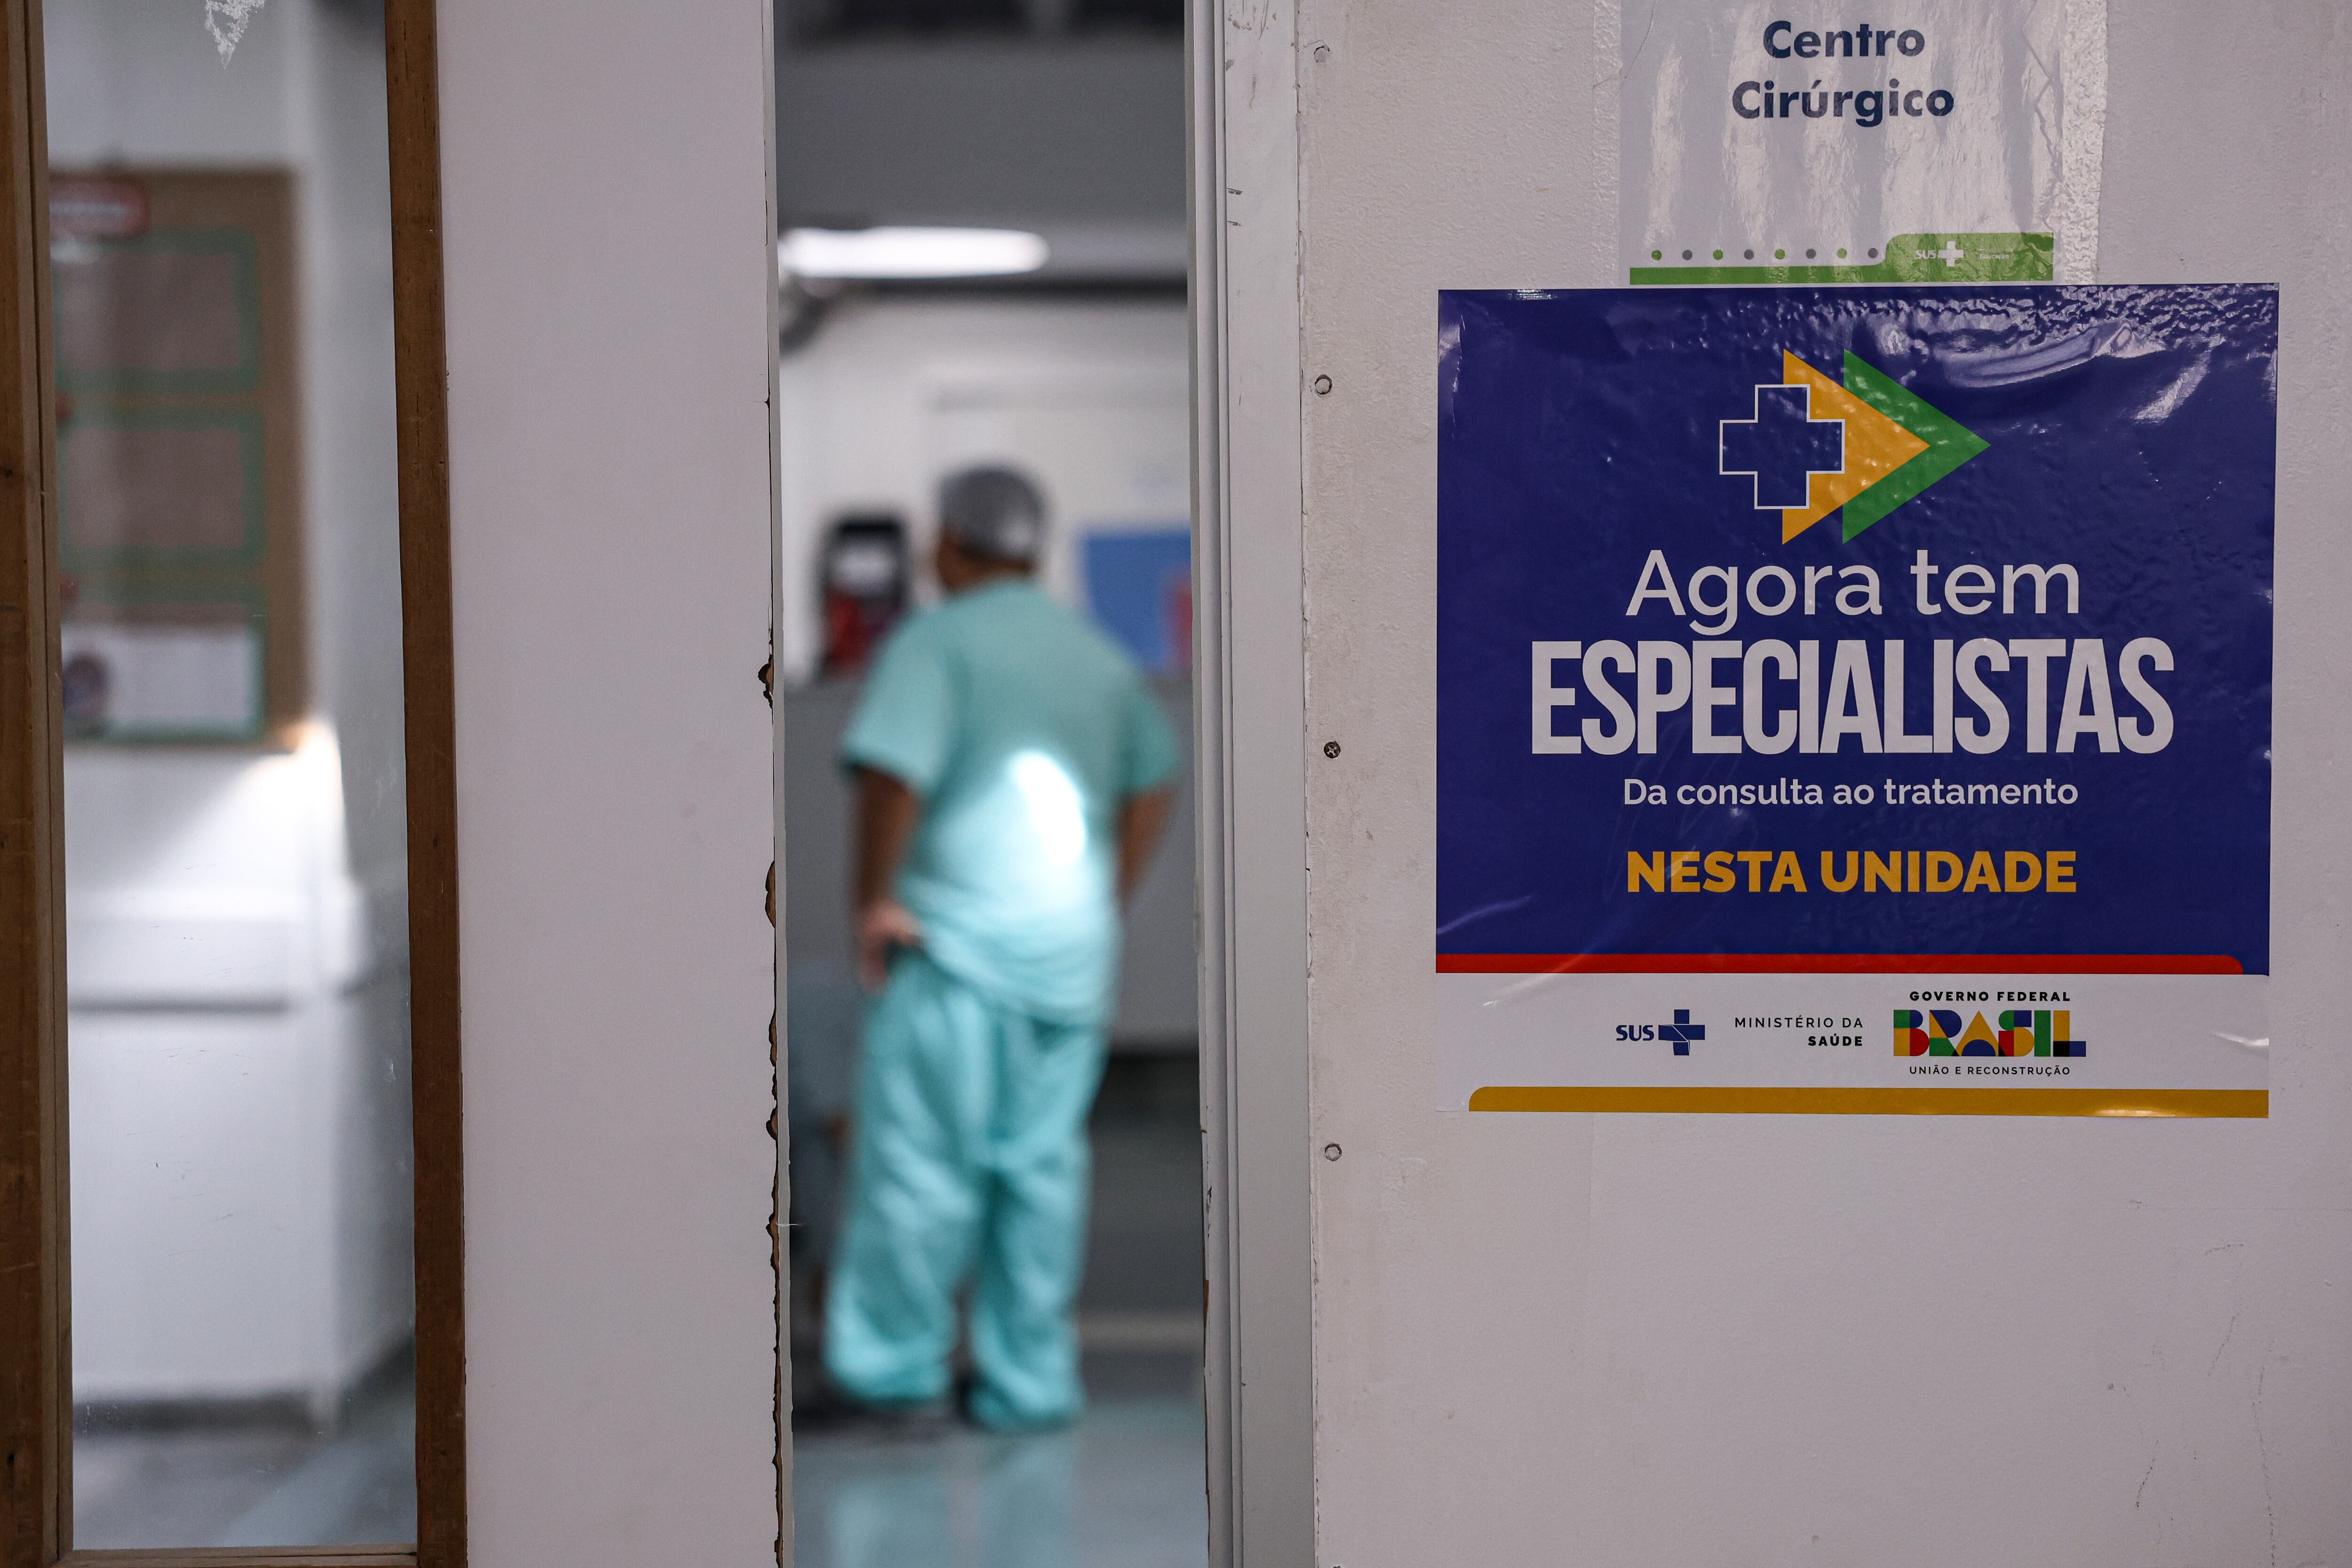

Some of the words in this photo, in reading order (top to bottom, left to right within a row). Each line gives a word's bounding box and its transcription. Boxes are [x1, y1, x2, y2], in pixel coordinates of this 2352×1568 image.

[1763, 20, 1925, 59] Centro
[1732, 78, 1954, 127] Cirúrgico
[1915, 250, 1937, 259] SUS
[1626, 549, 1882, 636] Agora
[1910, 549, 2079, 615] tem
[1532, 637, 2174, 755] ESPECIALISTAS
[1624, 779, 1667, 805] Da
[1677, 778, 1823, 805] consulta
[1833, 784, 1874, 804] ao
[1884, 778, 2078, 804] tratamento
[1628, 851, 1807, 892] NESTA
[1821, 851, 2076, 892] UNIDADE
[1909, 991, 1989, 1002] GOVERNO
[1997, 991, 2070, 1002] FEDERAL
[1616, 1024, 1654, 1042] SUS
[1734, 1014, 1834, 1028] MINISTÉRIO
[1842, 1018, 1863, 1028] DA
[1893, 1010, 2086, 1057] BRASIL
[1808, 1033, 1863, 1046] SAÚDE
[1909, 1064, 1949, 1075] UNIÃO
[1968, 1064, 2070, 1077] RECONSTRUÇÃO
